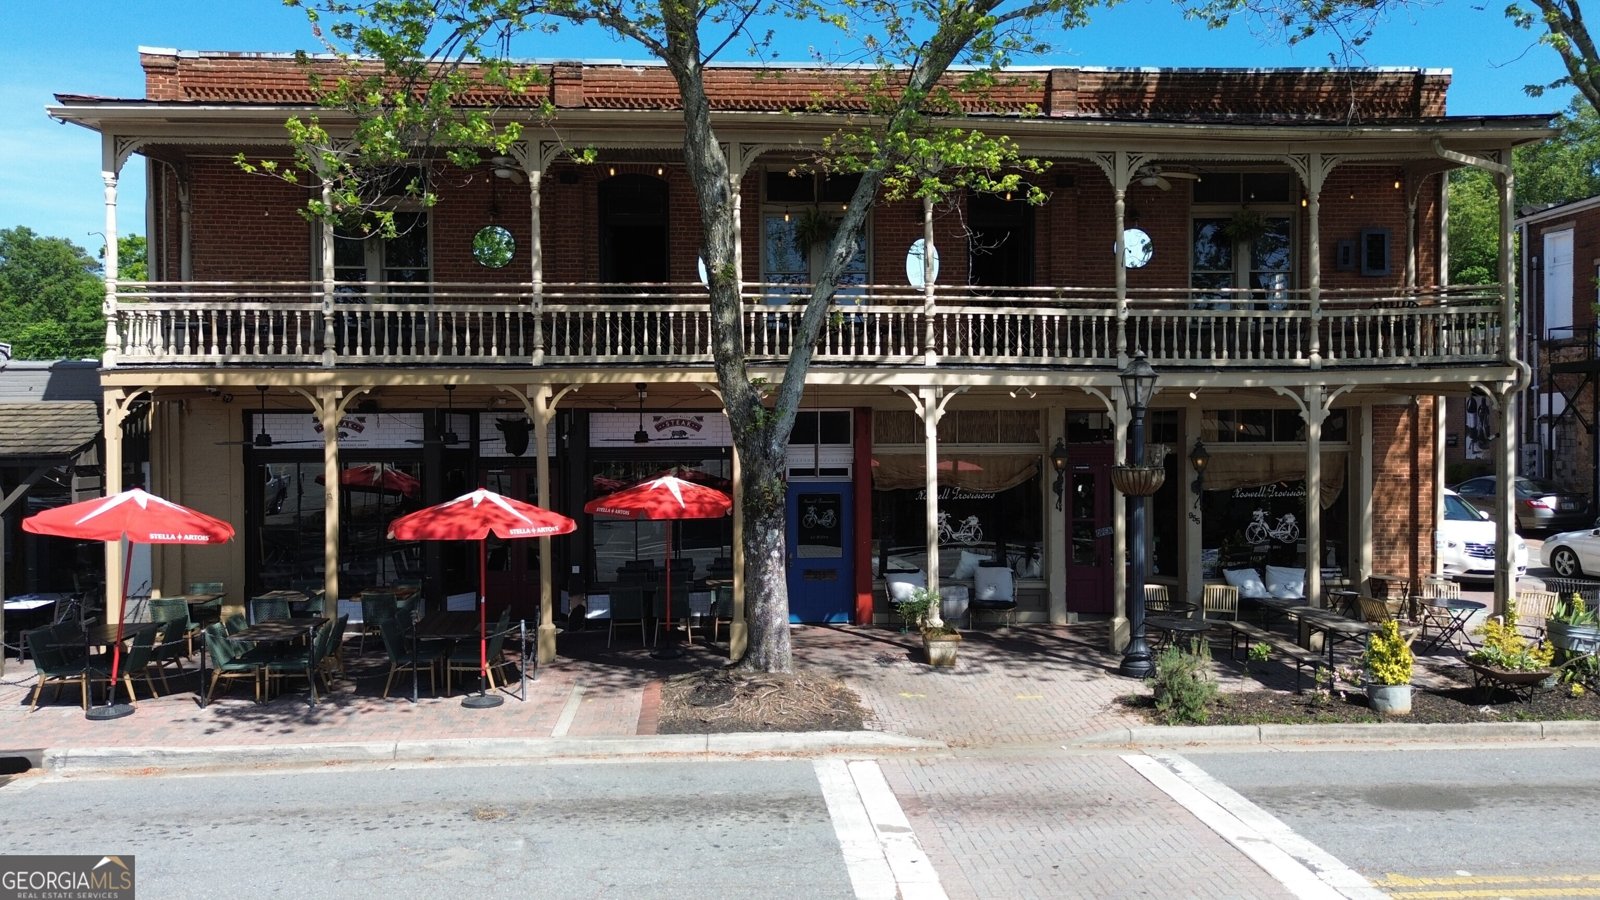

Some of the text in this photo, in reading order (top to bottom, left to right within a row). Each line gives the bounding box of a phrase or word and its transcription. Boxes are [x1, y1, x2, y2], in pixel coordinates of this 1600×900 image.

[666, 419, 692, 428] STEAK
[952, 486, 995, 500] Provisions
[1231, 484, 1307, 498] Roswell Provision
[509, 525, 560, 535] STELLA ARTOIS
[149, 532, 210, 542] STELLA ARTOIS
